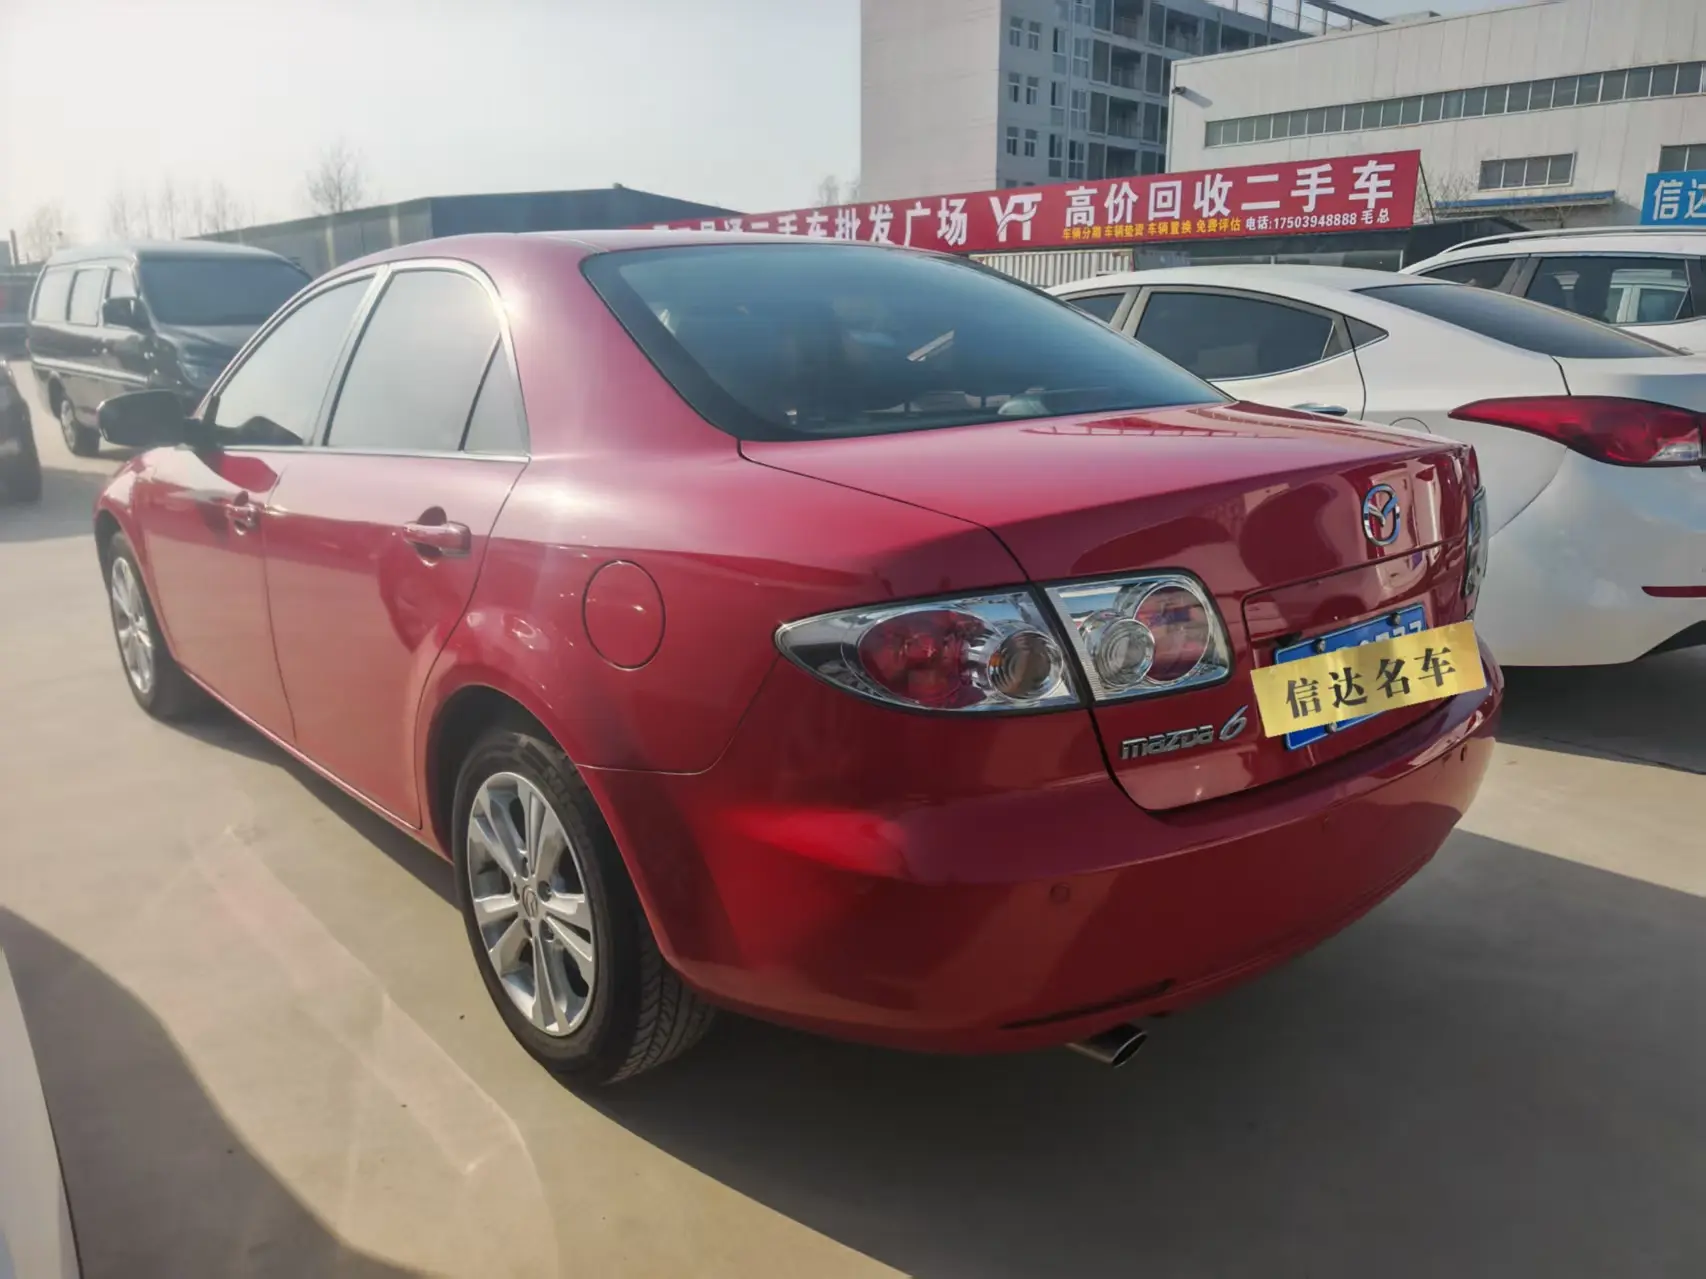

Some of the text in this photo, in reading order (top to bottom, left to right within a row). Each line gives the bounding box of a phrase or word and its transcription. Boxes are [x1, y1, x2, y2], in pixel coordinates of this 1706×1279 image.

[1064, 160, 1396, 227] 高价回收二手车
[1196, 216, 1241, 233] 免费评估
[1286, 646, 1456, 719] 信达名车
[1218, 704, 1249, 742] 6
